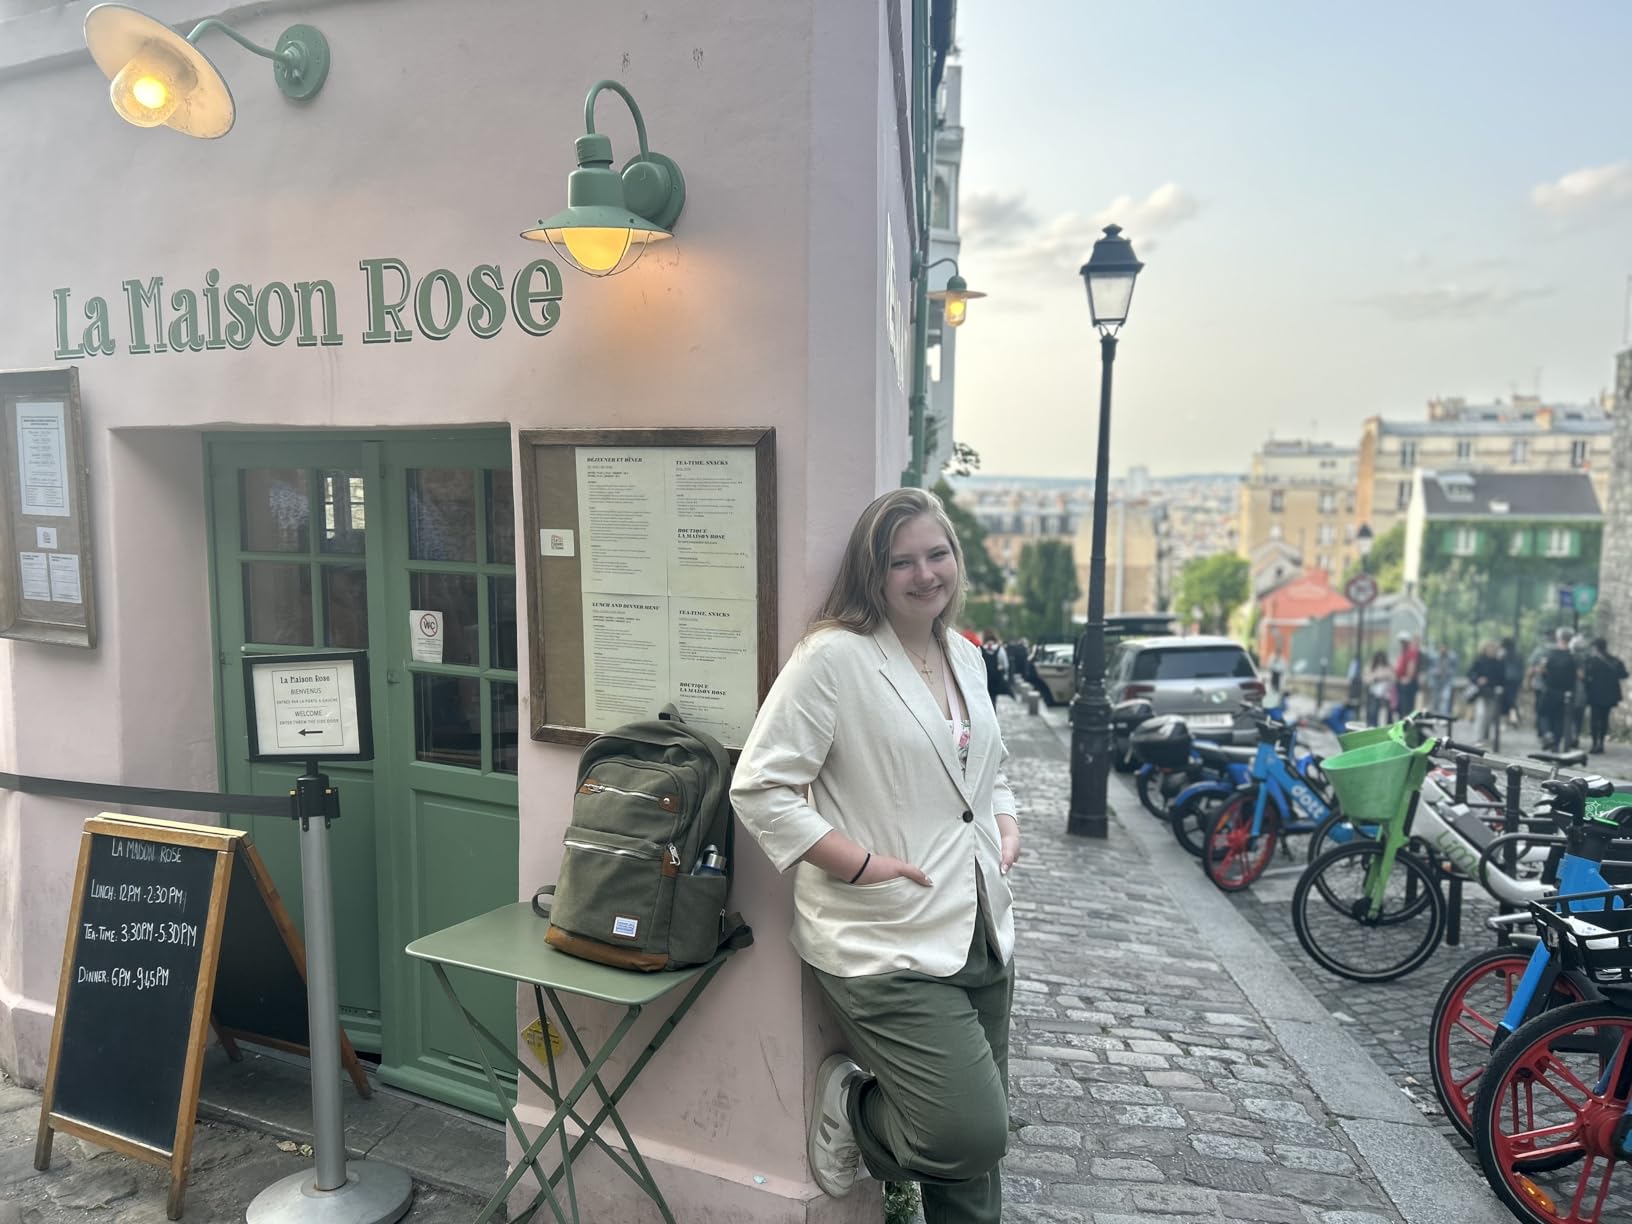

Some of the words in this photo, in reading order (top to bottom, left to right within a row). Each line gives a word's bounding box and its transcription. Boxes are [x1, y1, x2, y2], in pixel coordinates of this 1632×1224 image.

[53, 287, 116, 360] La
[122, 268, 344, 354] Maison
[359, 257, 563, 344] Rose
[423, 621, 436, 630] WC
[280, 676, 289, 684] La
[290, 675, 314, 684] Maison
[315, 674, 331, 682] Rose
[1291, 785, 1326, 820] dott
[111, 837, 123, 857] LA
[126, 839, 156, 862] MAISON
[160, 846, 182, 863] ROSE
